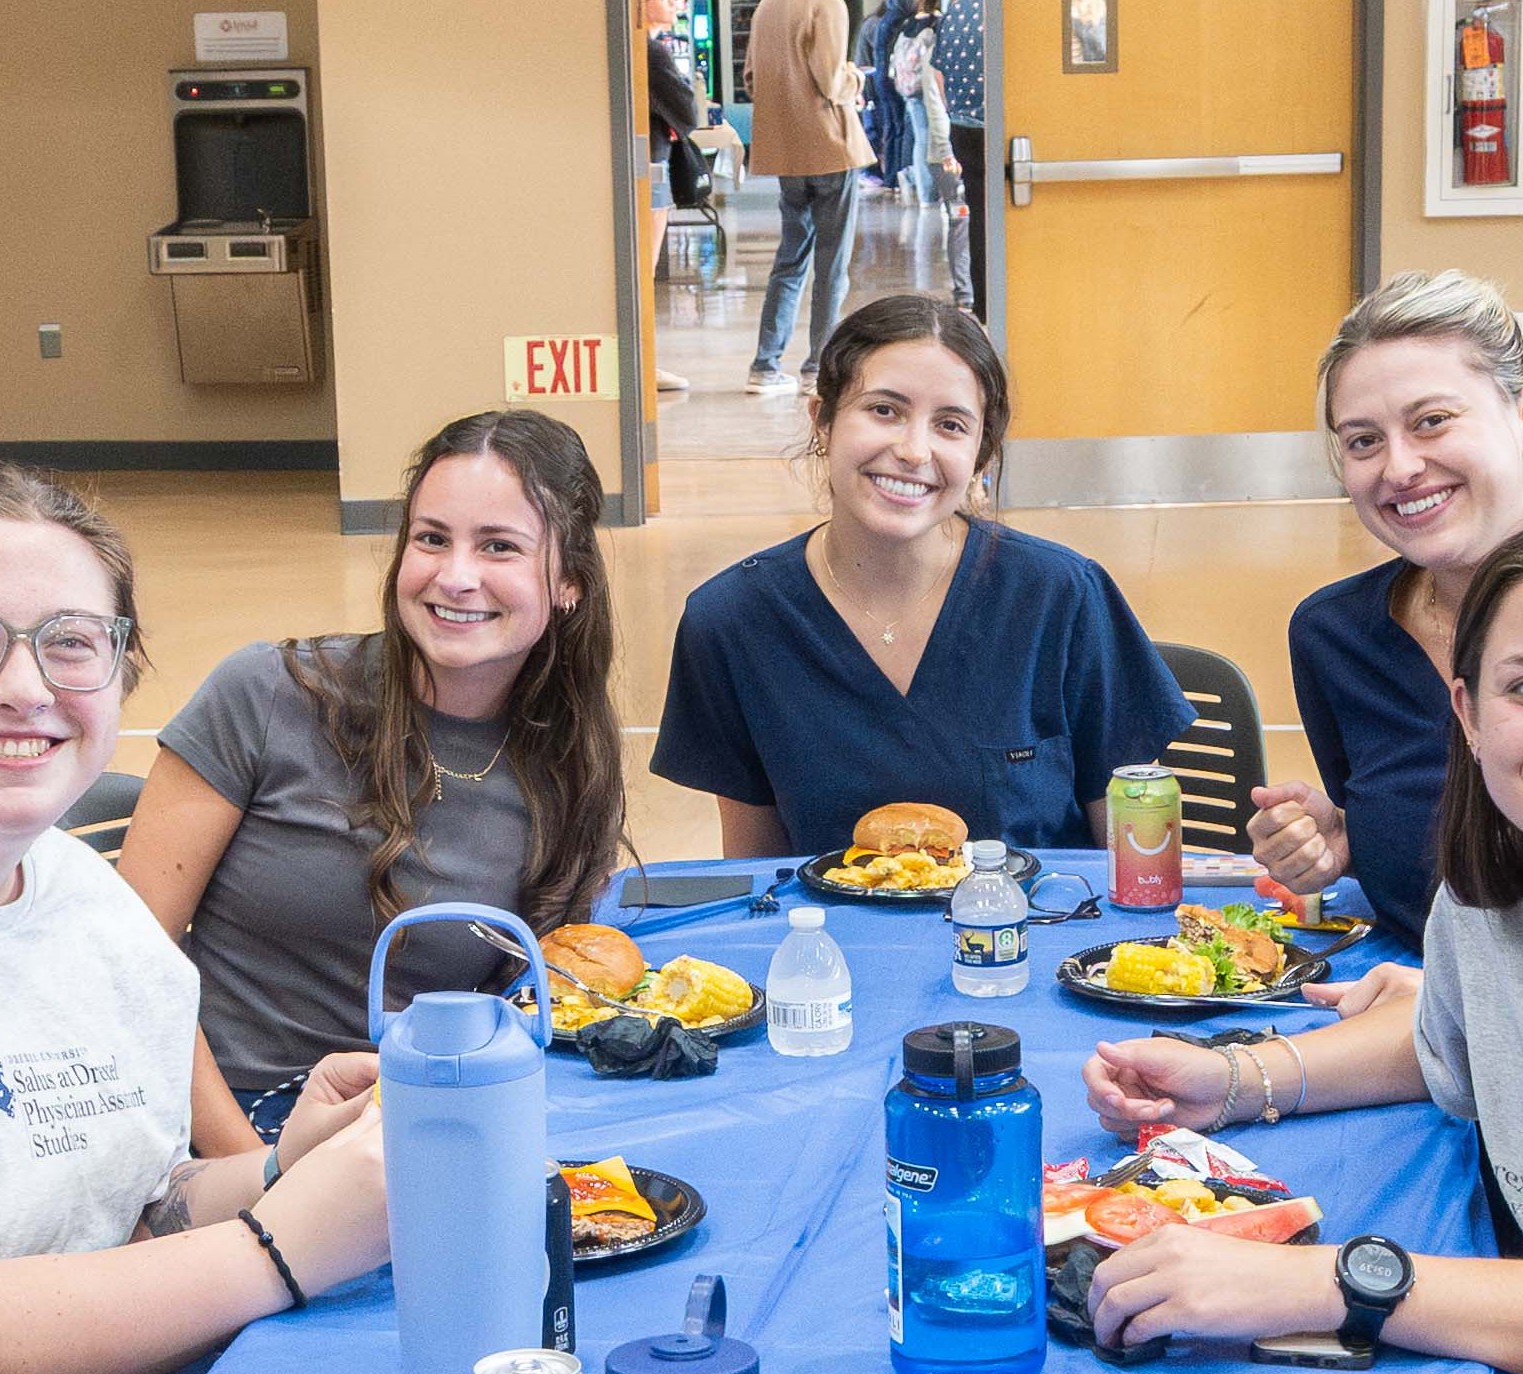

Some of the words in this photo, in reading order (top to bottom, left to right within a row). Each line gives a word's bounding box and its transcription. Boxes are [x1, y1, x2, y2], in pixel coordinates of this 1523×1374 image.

[526, 339, 602, 395] EXIT
[12, 1066, 56, 1095] Salus
[57, 1071, 75, 1089] at
[70, 1055, 120, 1086] Drexel
[98, 1086, 147, 1115] Assnt
[887, 1162, 934, 1186] algene
[1358, 1262, 1392, 1278] 05:39
